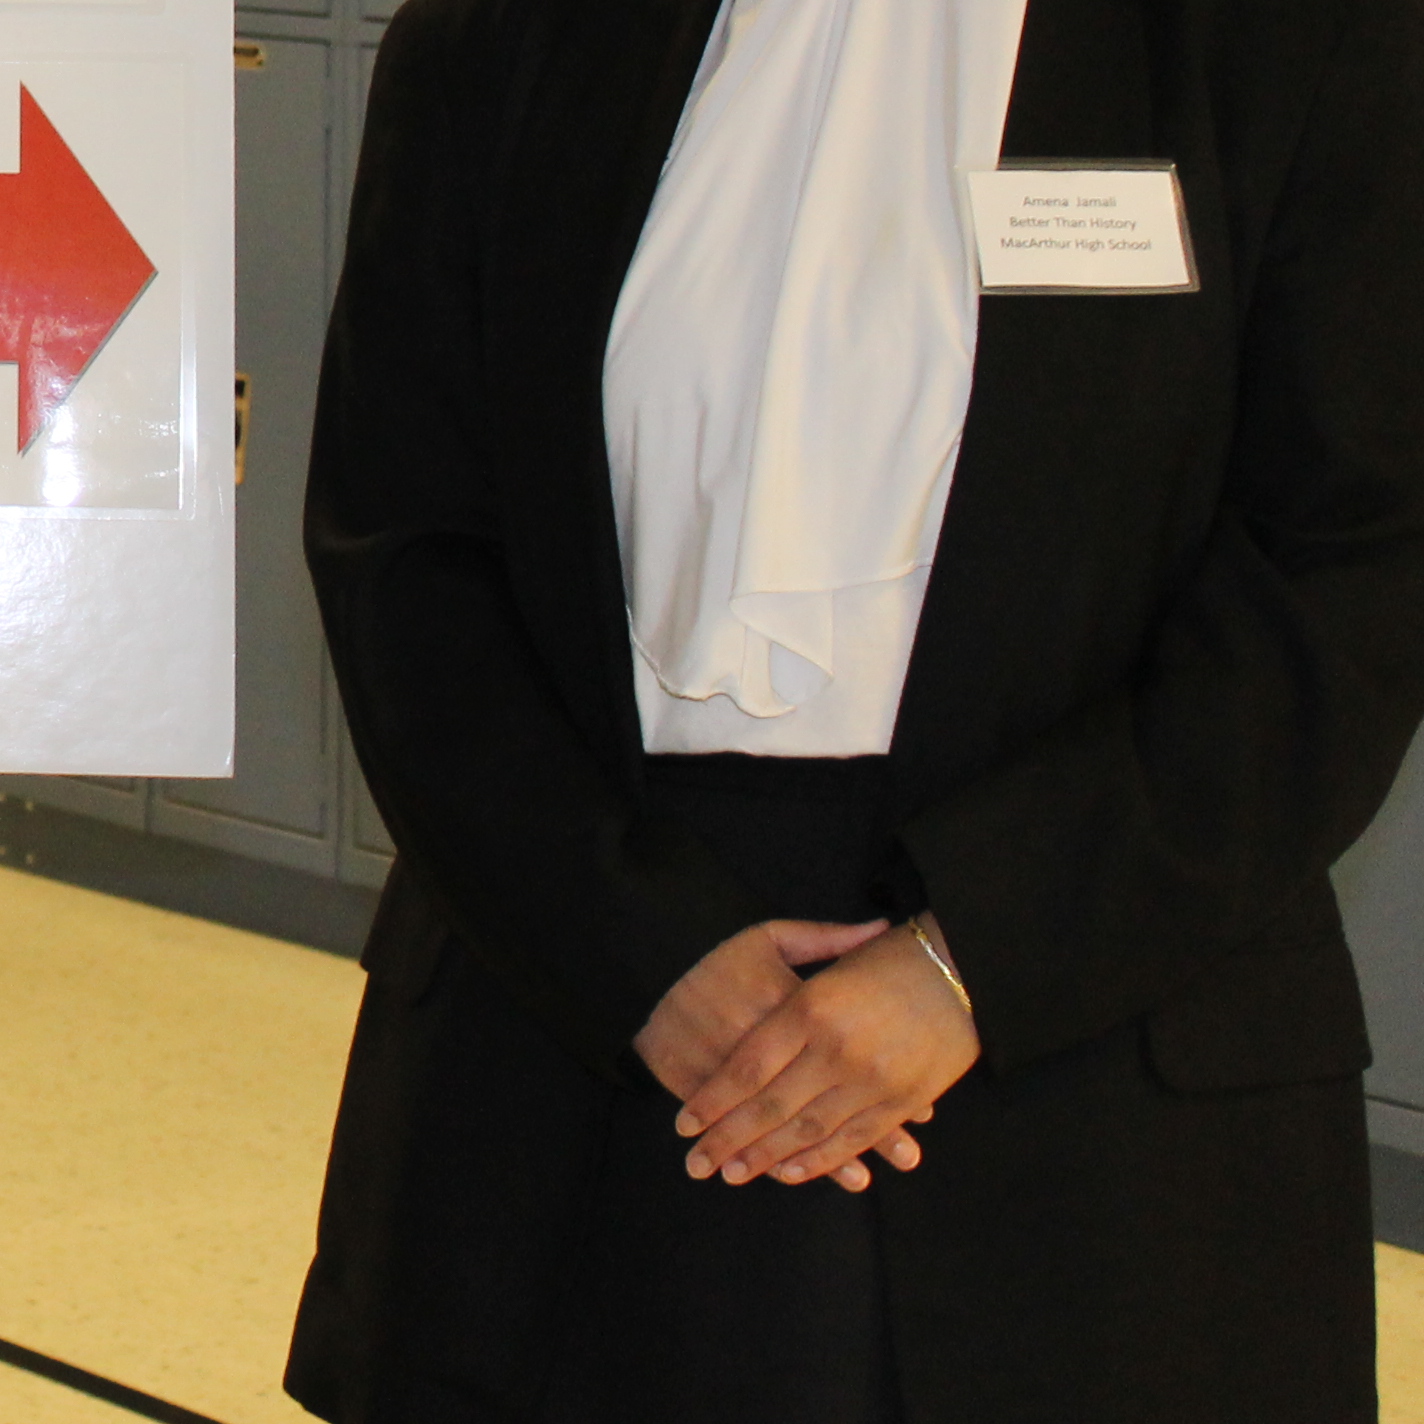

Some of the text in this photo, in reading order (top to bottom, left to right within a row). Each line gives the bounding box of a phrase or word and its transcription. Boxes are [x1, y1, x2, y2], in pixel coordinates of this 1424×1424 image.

[1010, 217, 1136, 230] Better Than History
[1001, 238, 1151, 252] MacArthur High School
